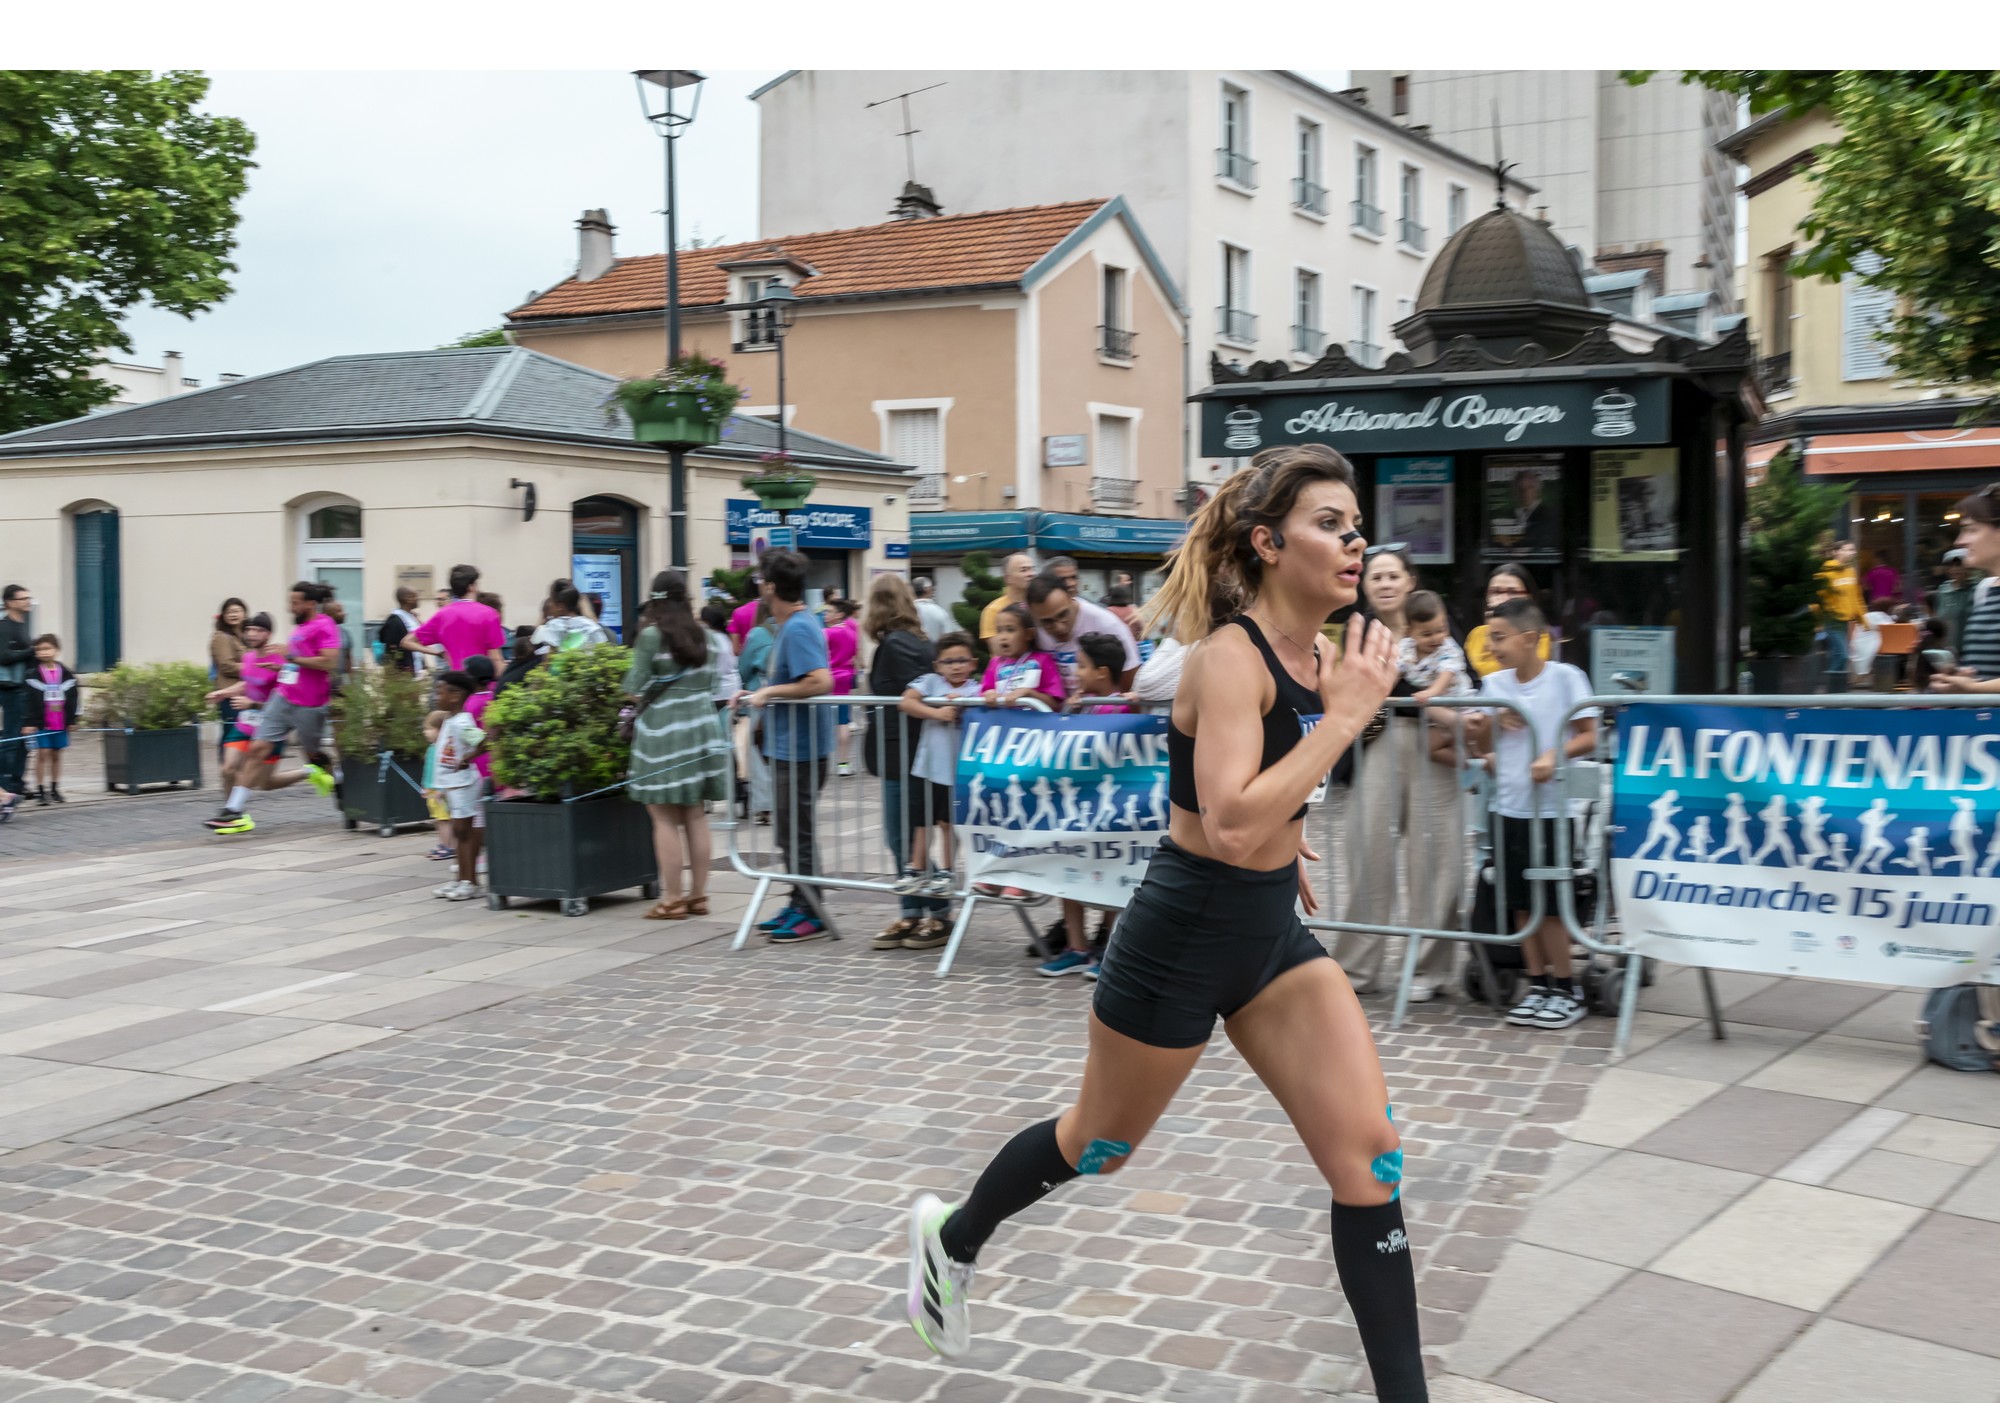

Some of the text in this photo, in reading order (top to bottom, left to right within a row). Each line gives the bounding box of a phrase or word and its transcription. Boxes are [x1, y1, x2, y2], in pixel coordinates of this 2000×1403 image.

[1284, 394, 1566, 442] Artisanal Burger
[748, 508, 856, 529] FontnaySCOPE
[961, 722, 1001, 762] LA
[1624, 725, 2000, 790] LA FONTENAIS
[1091, 840, 1122, 860] 15
[1631, 869, 1993, 928] Dimanche 15 juin
